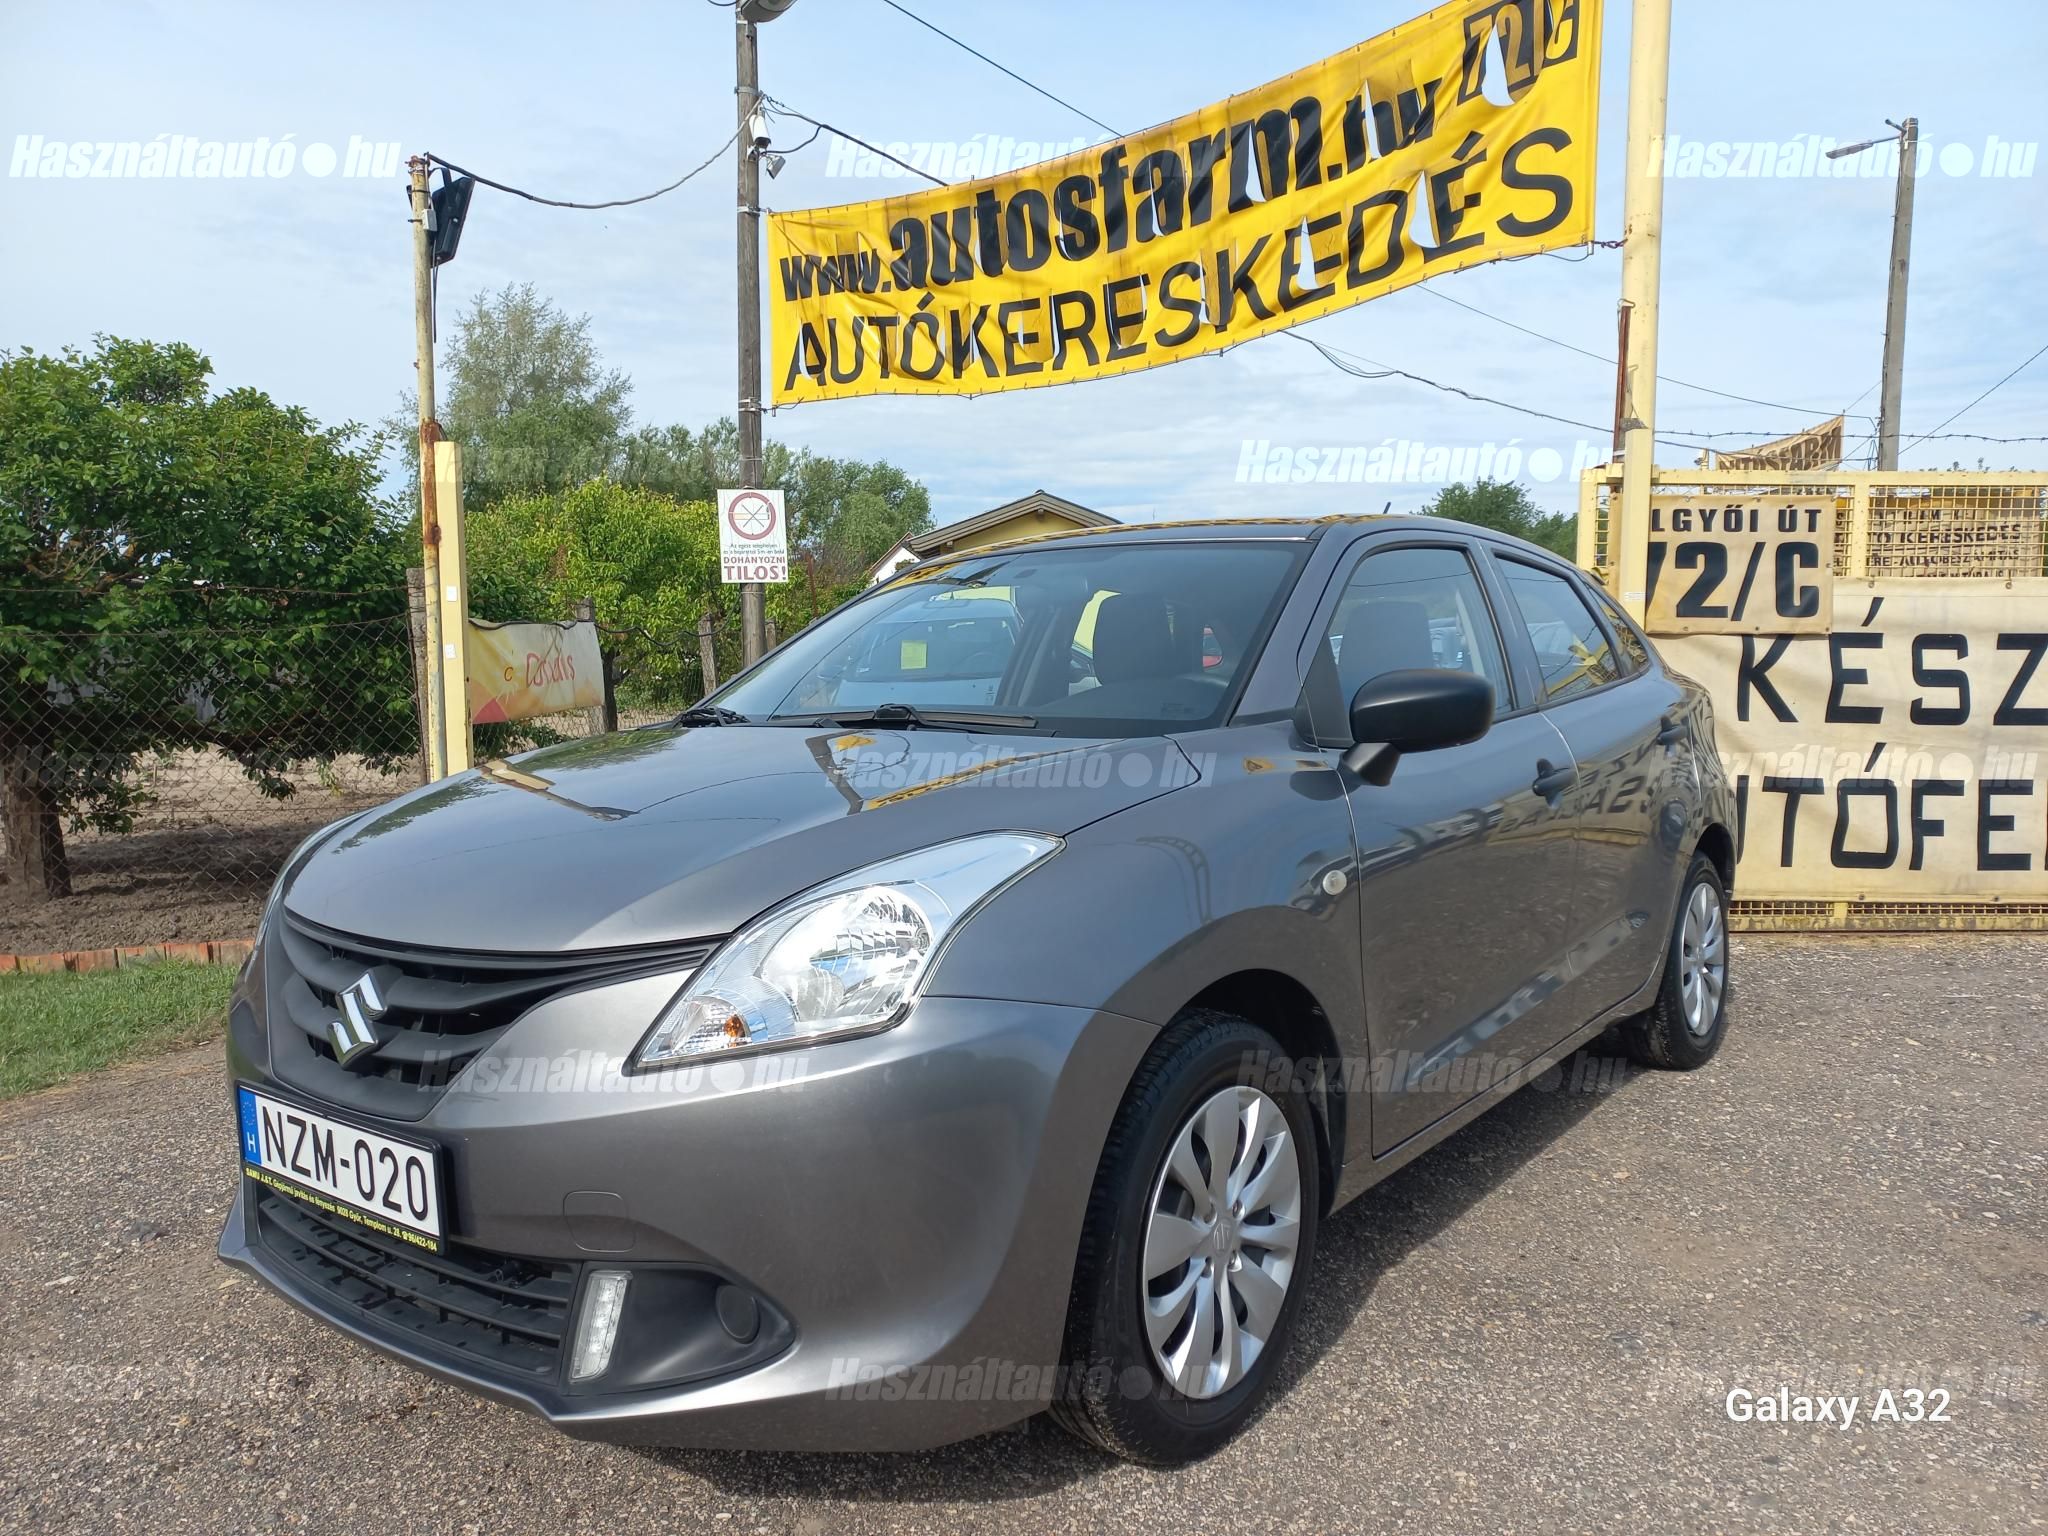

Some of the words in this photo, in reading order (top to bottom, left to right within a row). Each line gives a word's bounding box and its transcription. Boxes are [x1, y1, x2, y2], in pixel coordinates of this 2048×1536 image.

[784, 128, 1574, 391] AUTÓKERESKEDÉS
[1650, 505, 1759, 532] LGYŐI
[1777, 504, 1822, 532] ÚT
[723, 565, 787, 581] TILOS!
[245, 1132, 257, 1154] H
[262, 1105, 429, 1222] NZM-020
